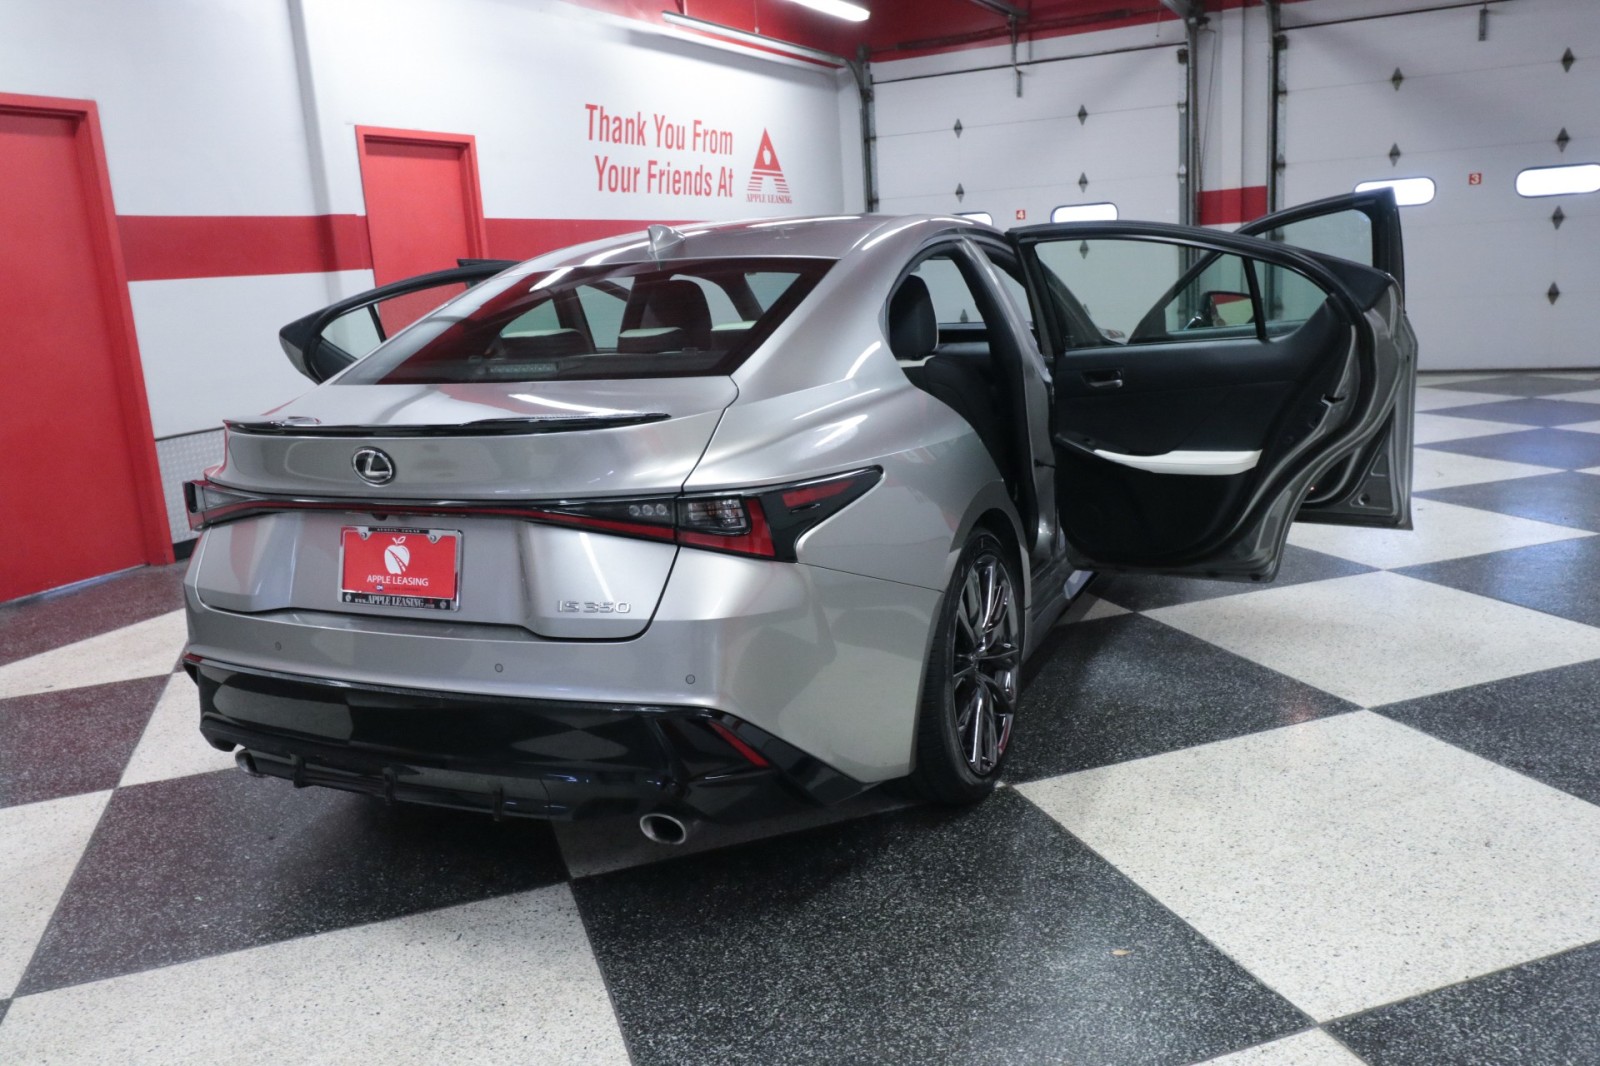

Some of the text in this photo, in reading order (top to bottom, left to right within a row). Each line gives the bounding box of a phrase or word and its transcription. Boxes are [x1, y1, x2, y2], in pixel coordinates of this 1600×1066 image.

[585, 103, 733, 155] Thank You From
[594, 155, 734, 198] Your Friends At
[1470, 173, 1481, 185] 3
[746, 193, 792, 205] APPLE LEASING
[1016, 209, 1025, 220] 4
[367, 574, 429, 587] APPLE LEASING
[557, 600, 631, 613] IS 350
